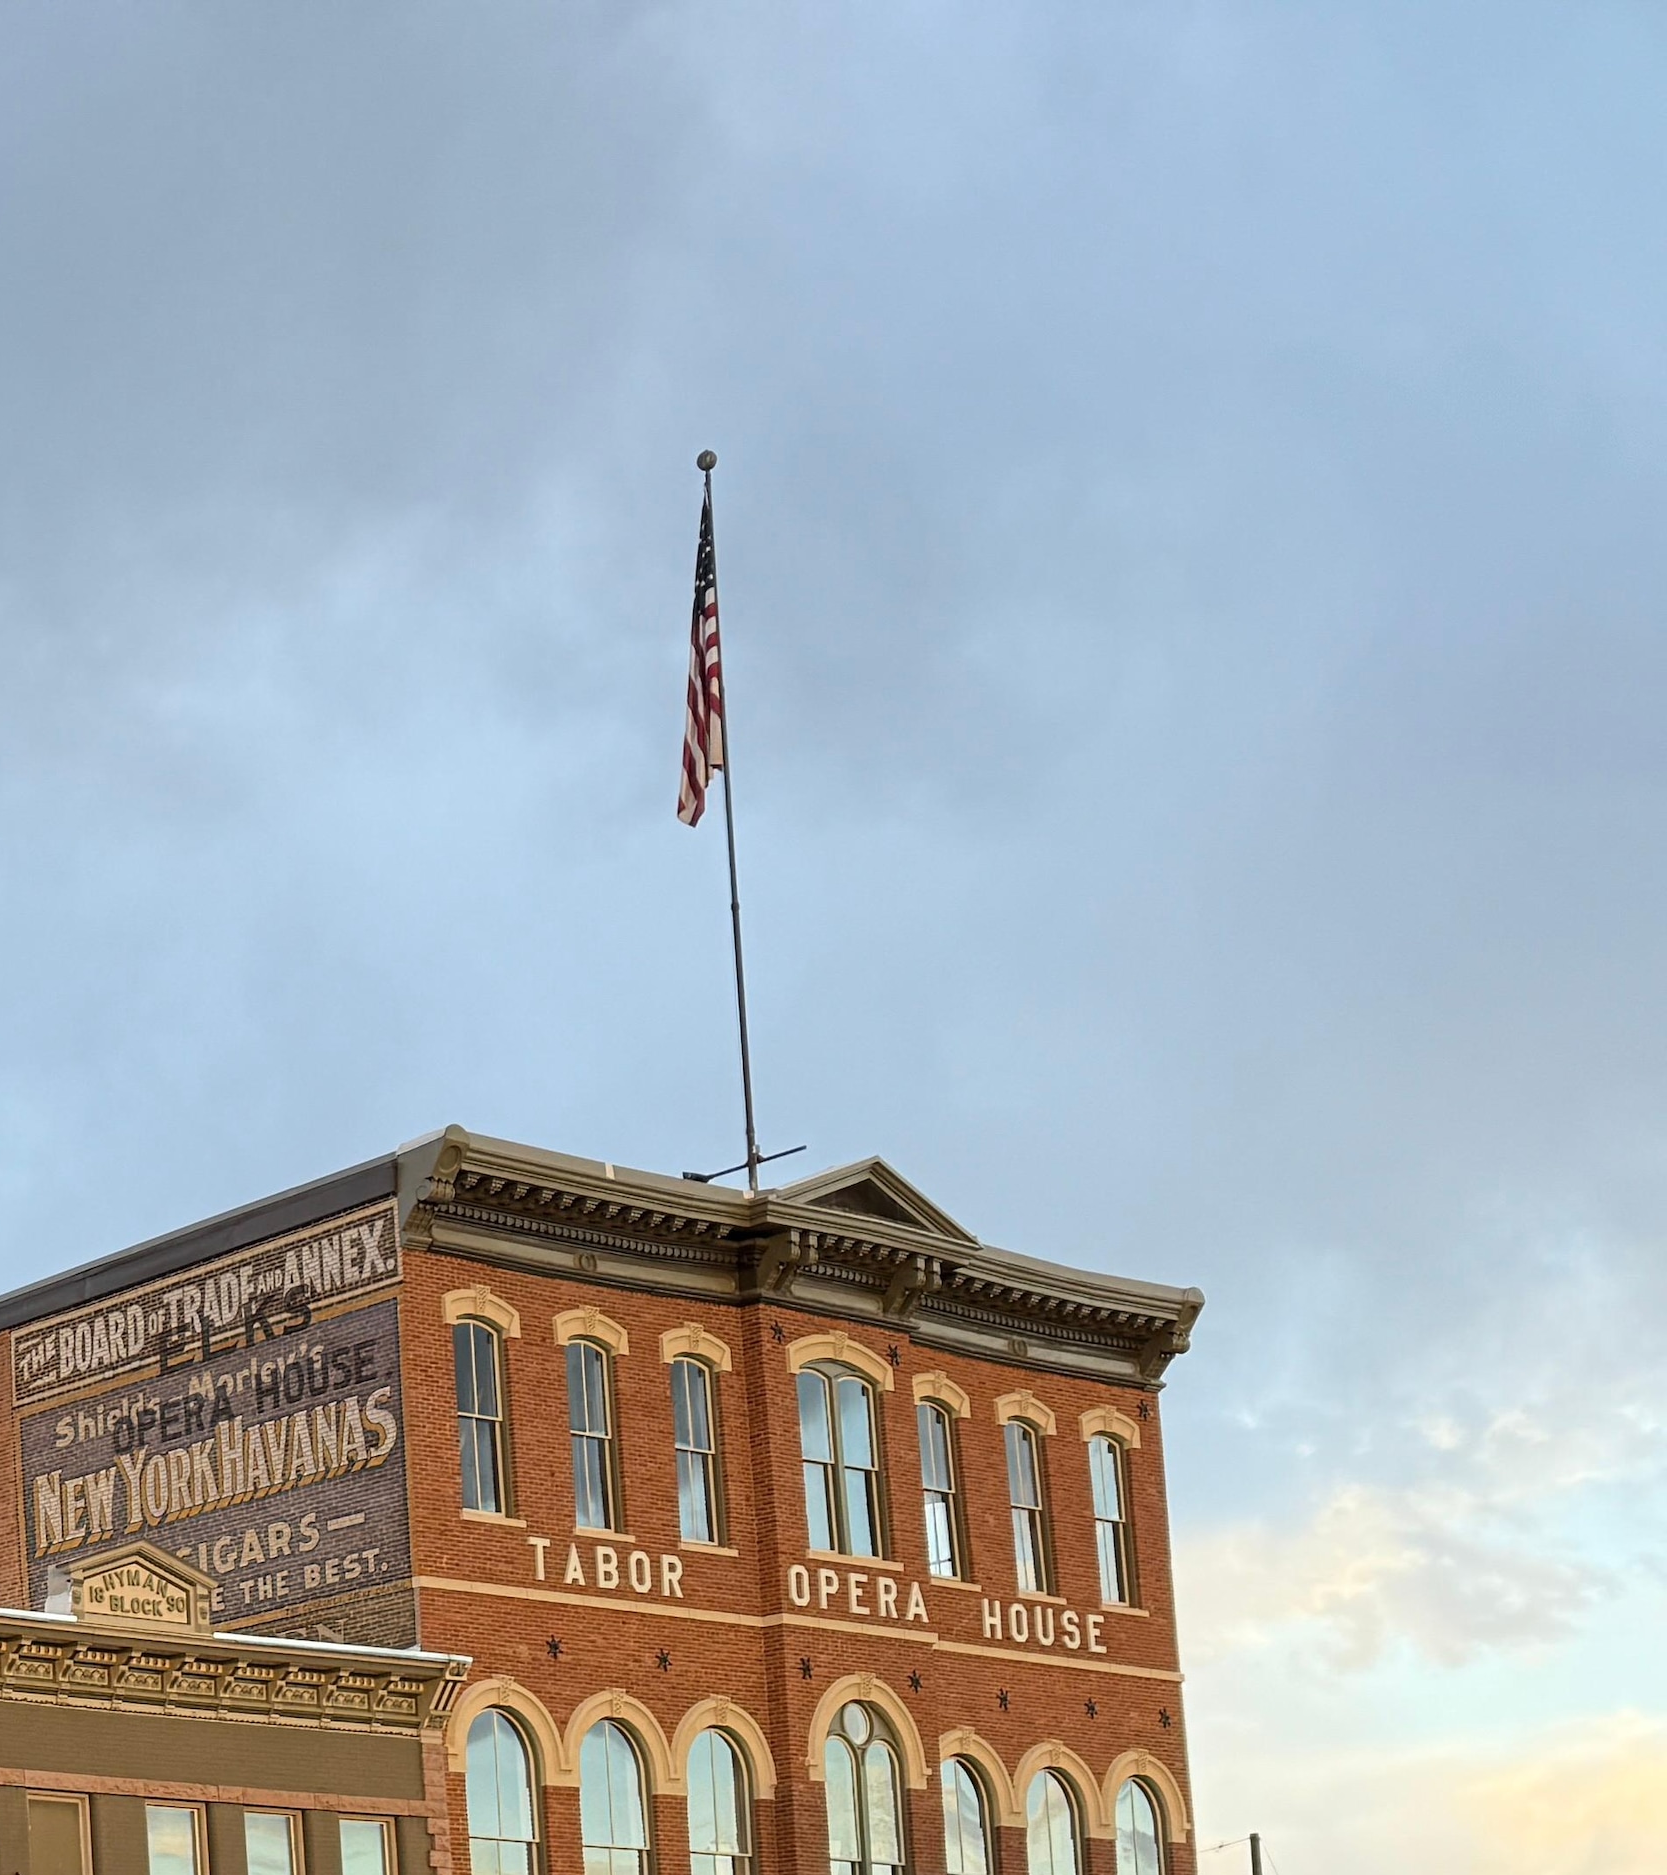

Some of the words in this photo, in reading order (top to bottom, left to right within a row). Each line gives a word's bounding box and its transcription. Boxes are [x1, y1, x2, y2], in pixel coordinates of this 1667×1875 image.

[19, 1333, 57, 1390] THE
[59, 1304, 145, 1380] BOARD
[148, 1309, 165, 1336] OF
[163, 1264, 257, 1341] TRADE
[257, 1268, 284, 1296] AND
[282, 1219, 396, 1298] ANNEX.
[33, 1467, 117, 1553] NEW
[118, 1438, 218, 1528] YORK
[216, 1386, 399, 1502] HAVANAS
[89, 1585, 106, 1604] 18
[103, 1569, 169, 1599] HYMAN
[240, 1571, 291, 1605] THE
[304, 1548, 390, 1590] BEST.
[526, 1535, 685, 1599] TABOR
[787, 1564, 930, 1624] OPERA
[980, 1597, 1109, 1654] HOUSE
[109, 1594, 164, 1617] BLOCK
[166, 1595, 185, 1613] 90
